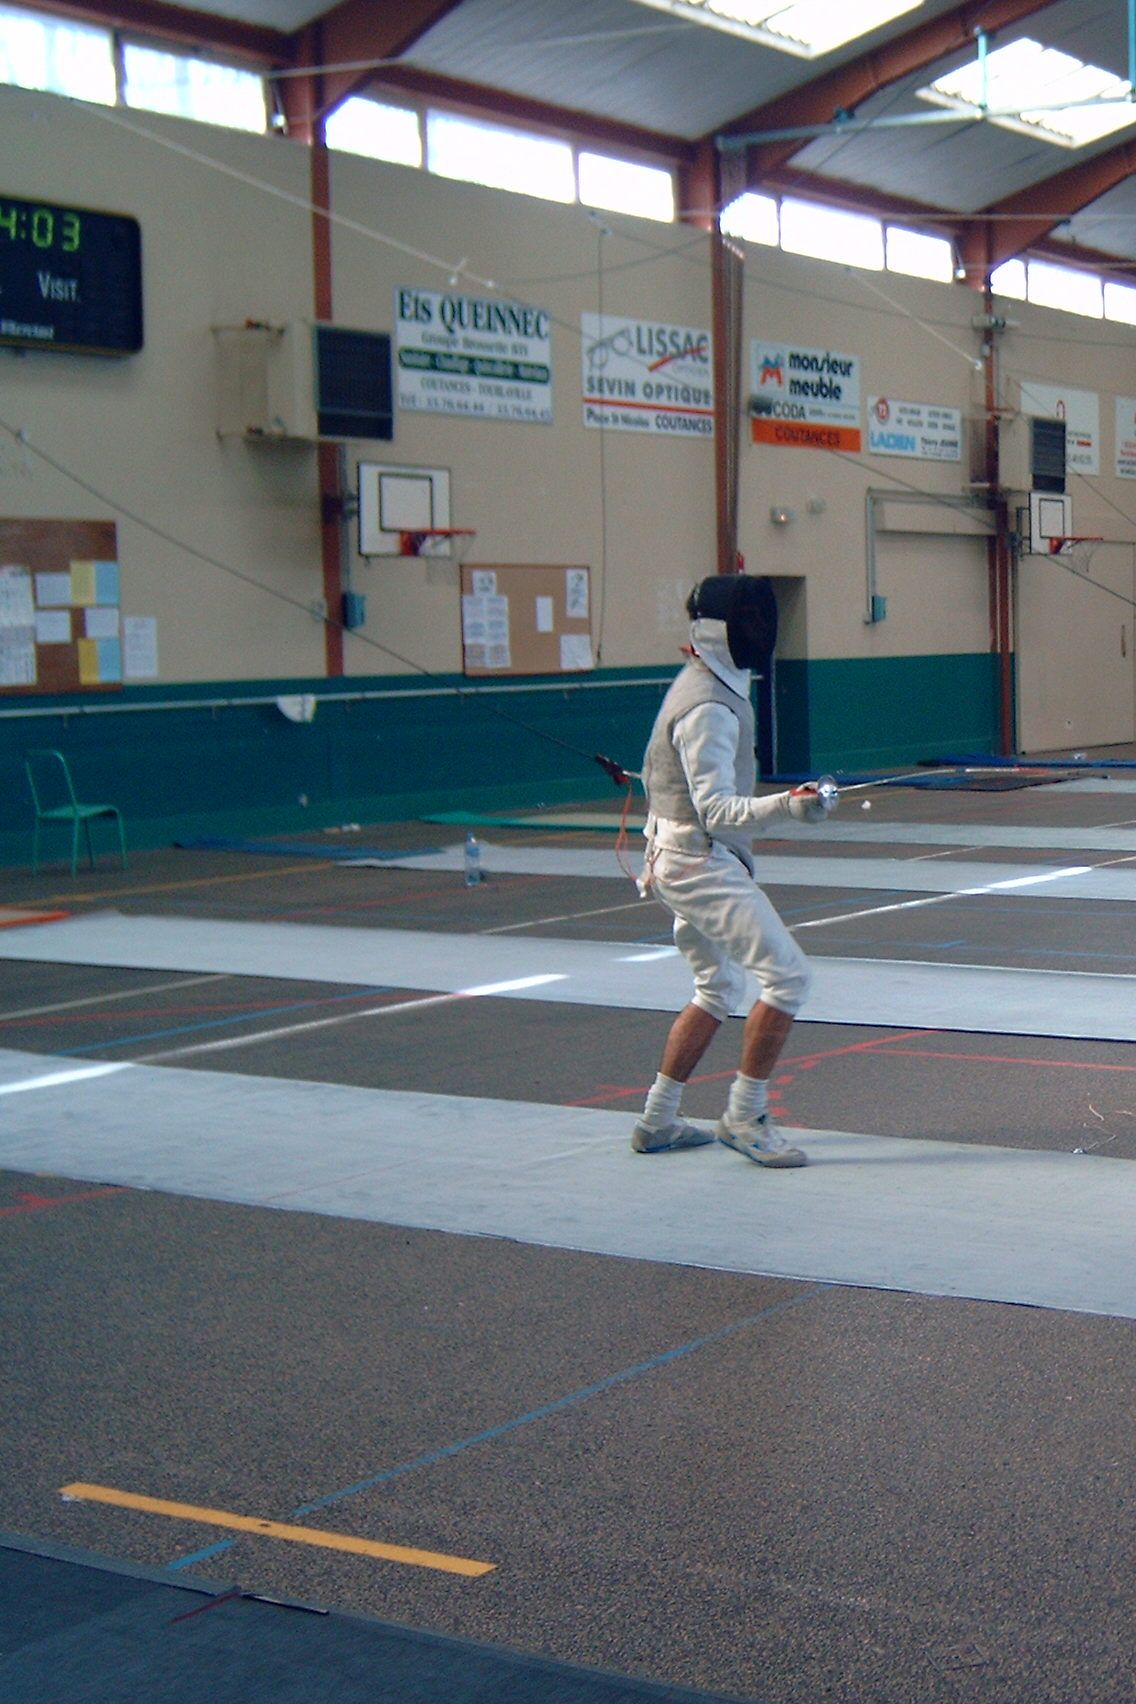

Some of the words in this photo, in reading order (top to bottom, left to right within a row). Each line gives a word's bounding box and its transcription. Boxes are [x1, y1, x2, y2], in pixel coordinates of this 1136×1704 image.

[440, 295, 549, 340] QUEINNEC
[635, 325, 709, 363] LISSAC
[788, 351, 854, 377] monsieur
[586, 376, 636, 397] SEVIN
[642, 381, 711, 405] OPTIQUE
[788, 376, 843, 400] meuble
